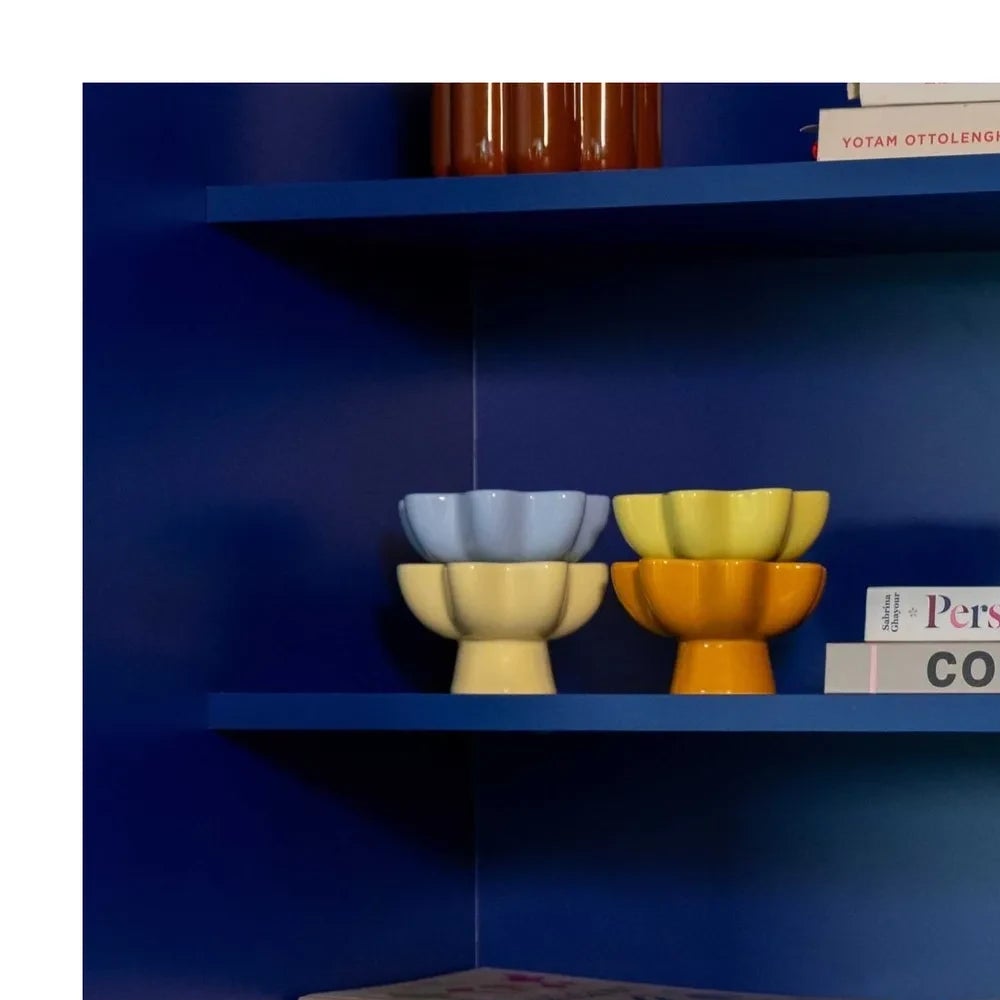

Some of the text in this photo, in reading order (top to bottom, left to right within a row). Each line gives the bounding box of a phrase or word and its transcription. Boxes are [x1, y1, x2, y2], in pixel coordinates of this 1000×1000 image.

[842, 135, 898, 149] YOTAM
[881, 594, 891, 631] Sabrina
[890, 592, 900, 633] Ghayour
